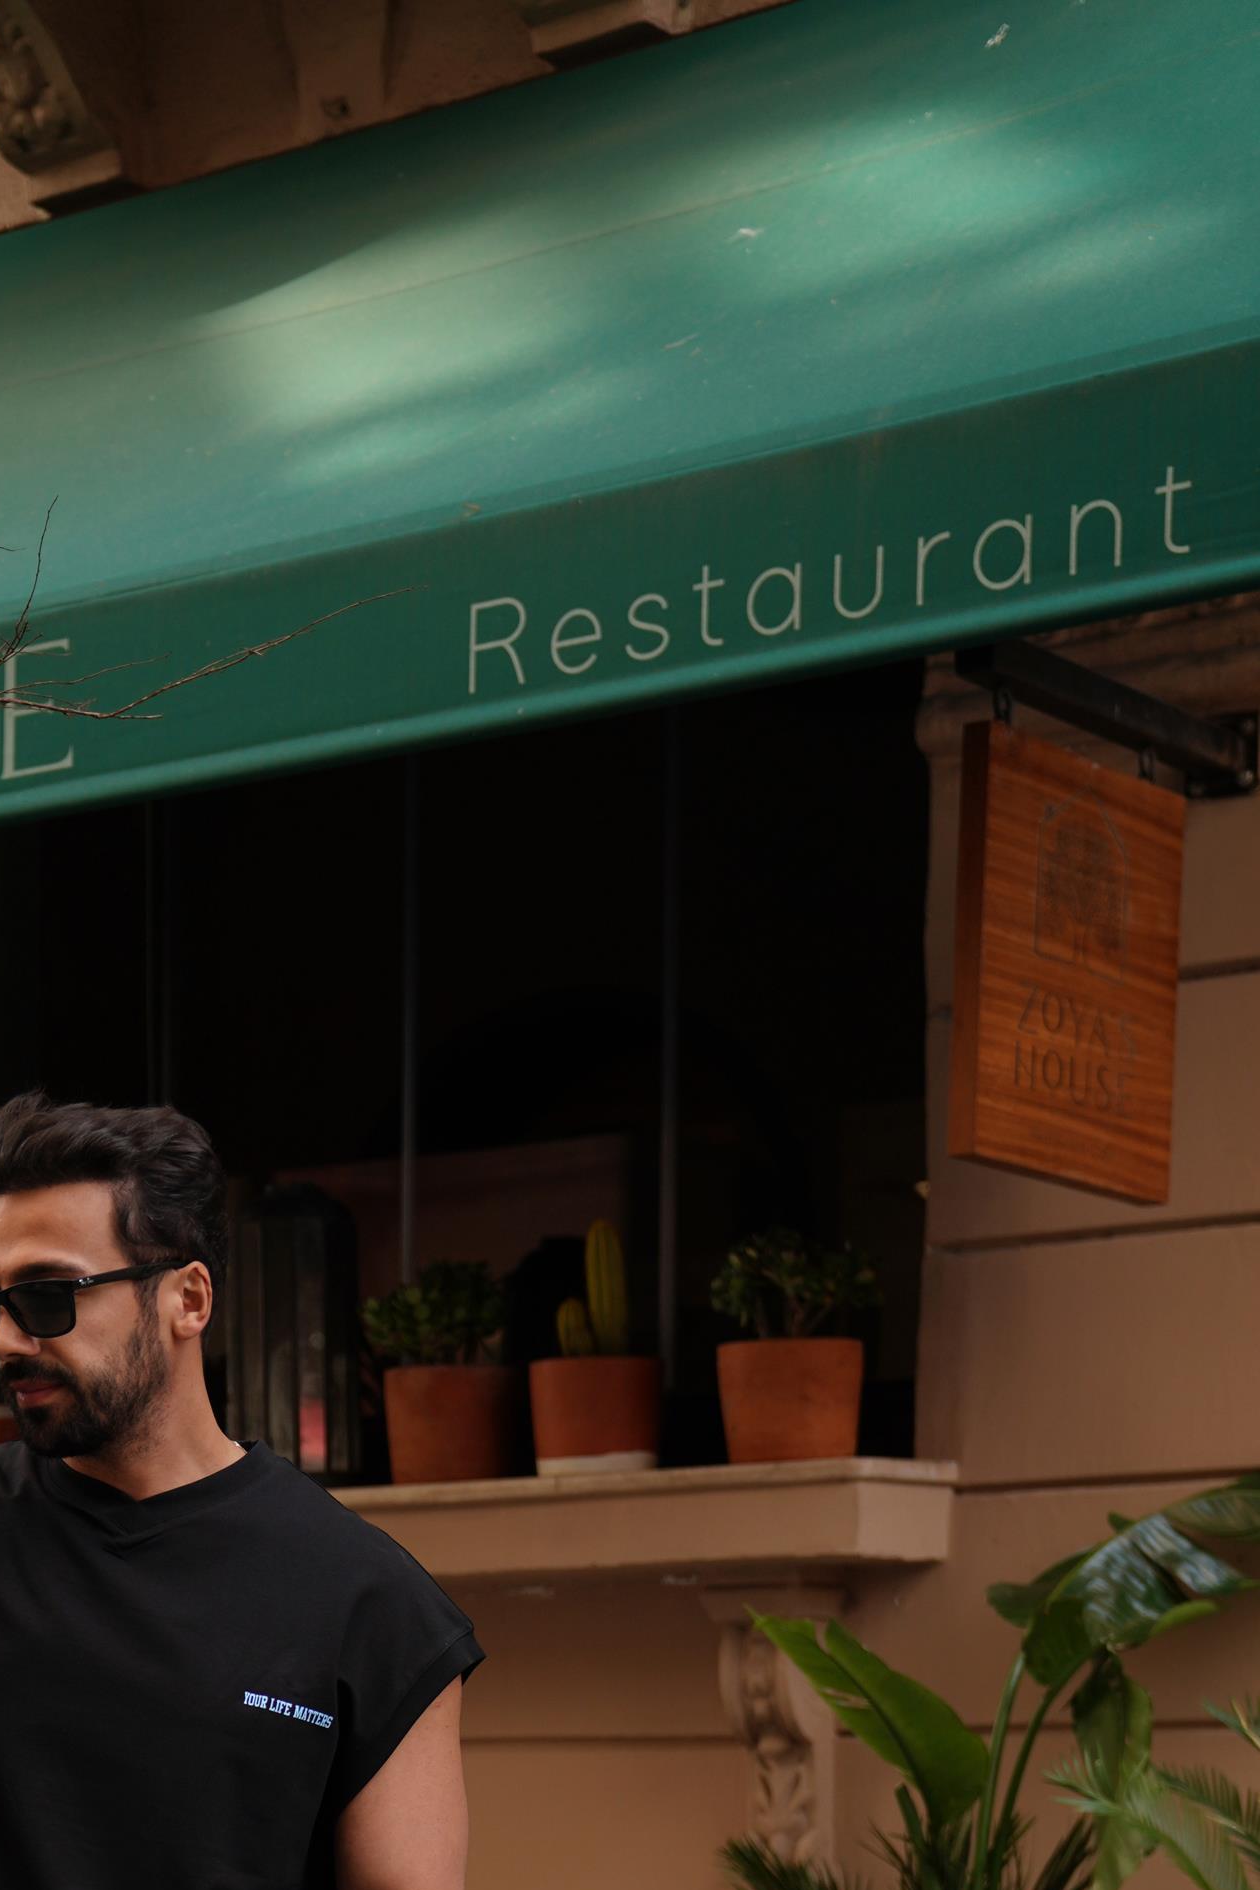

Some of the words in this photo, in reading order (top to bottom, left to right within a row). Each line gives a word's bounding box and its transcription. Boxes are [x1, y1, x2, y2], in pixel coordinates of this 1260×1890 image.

[468, 465, 1192, 694] Restaurant
[1013, 1040, 1135, 1120] HOUSE
[244, 1691, 268, 1709] YOUR
[269, 1698, 293, 1716] LIFE
[293, 1705, 333, 1729] MATTERS
